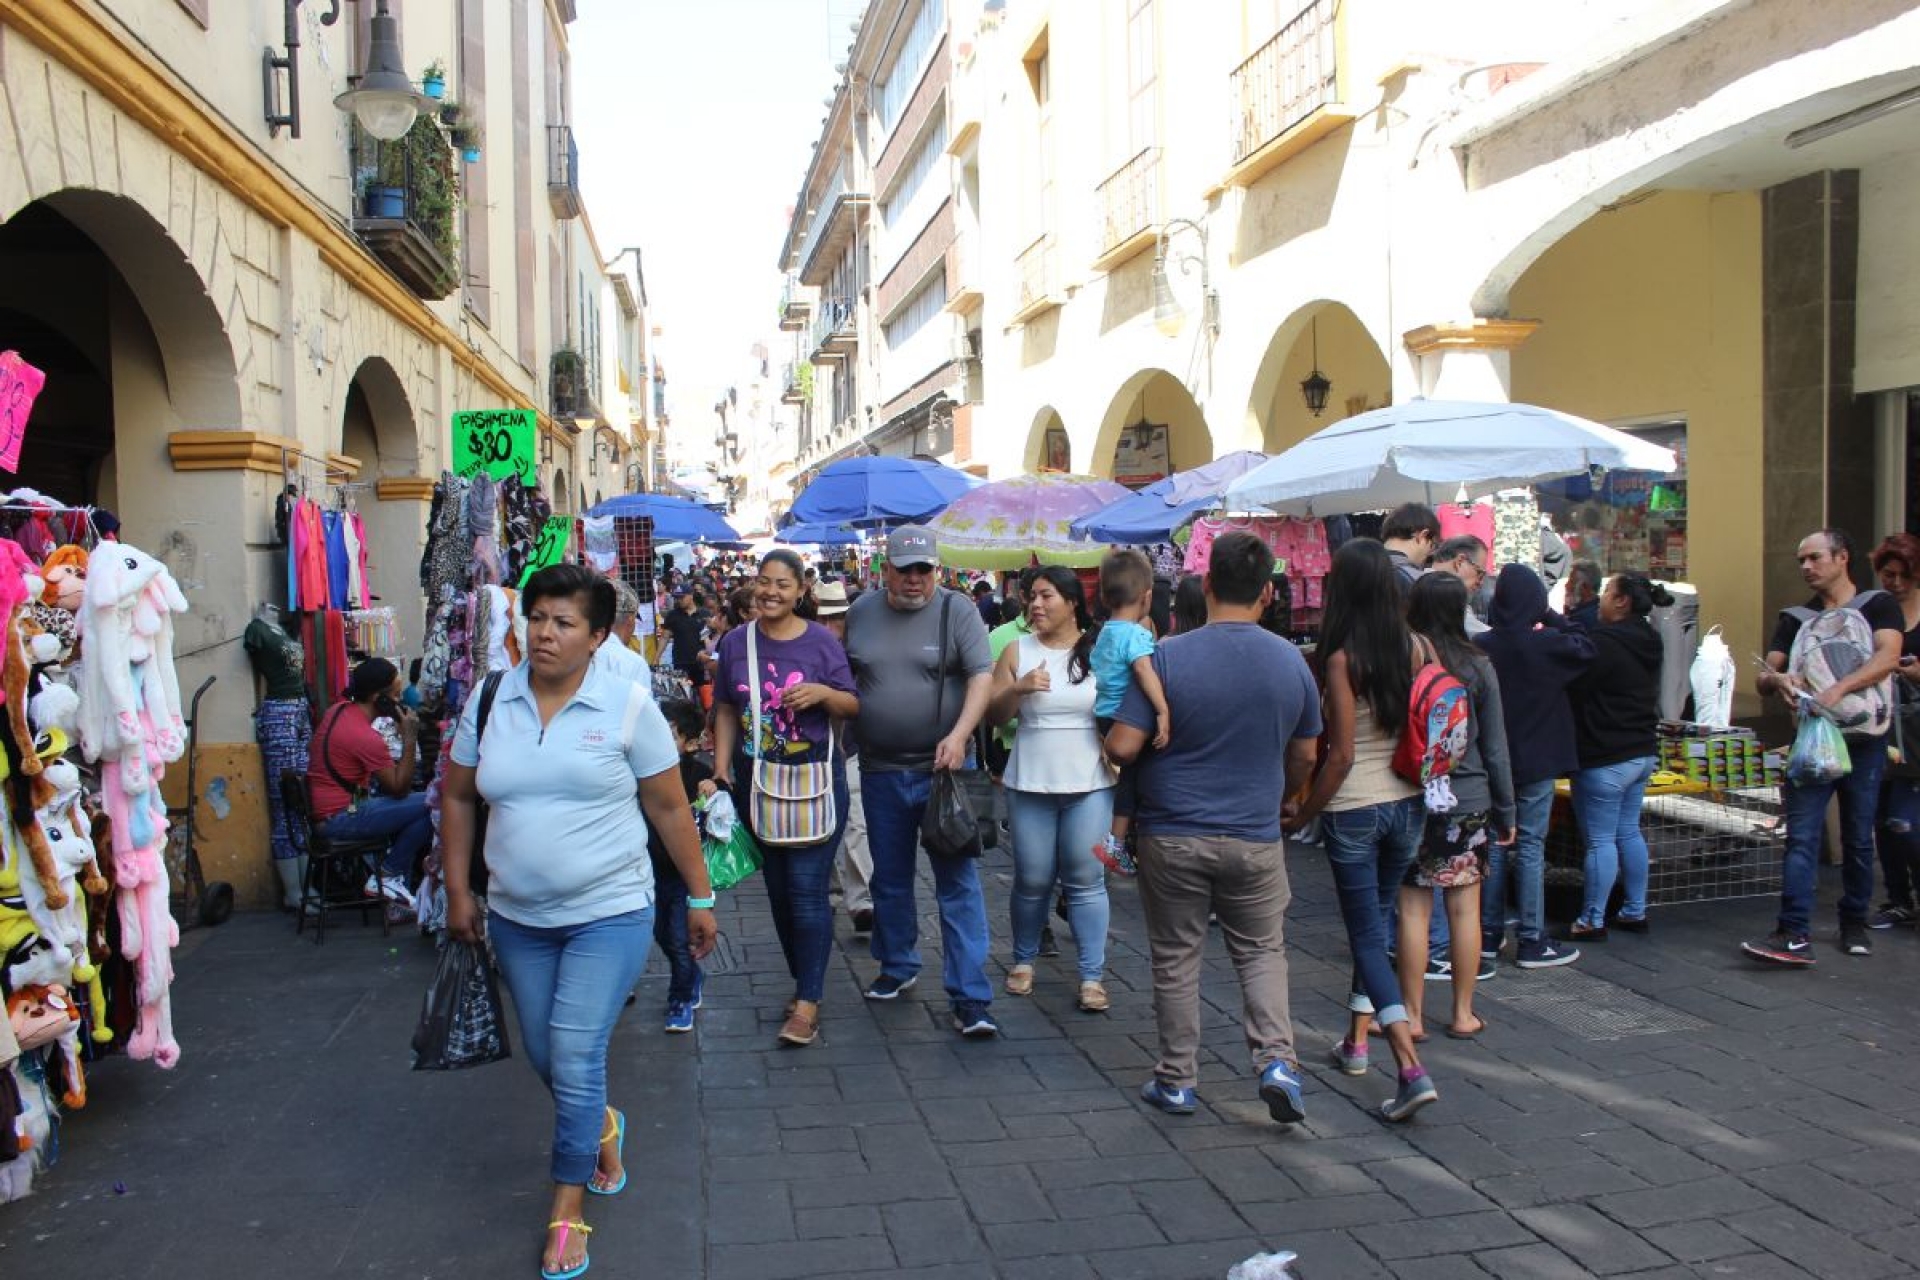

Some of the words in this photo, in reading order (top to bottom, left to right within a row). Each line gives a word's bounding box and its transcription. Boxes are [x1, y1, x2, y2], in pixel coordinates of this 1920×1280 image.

[459, 412, 527, 429] PASHMINA
[468, 428, 513, 465] $30
[903, 537, 926, 547] FILA
